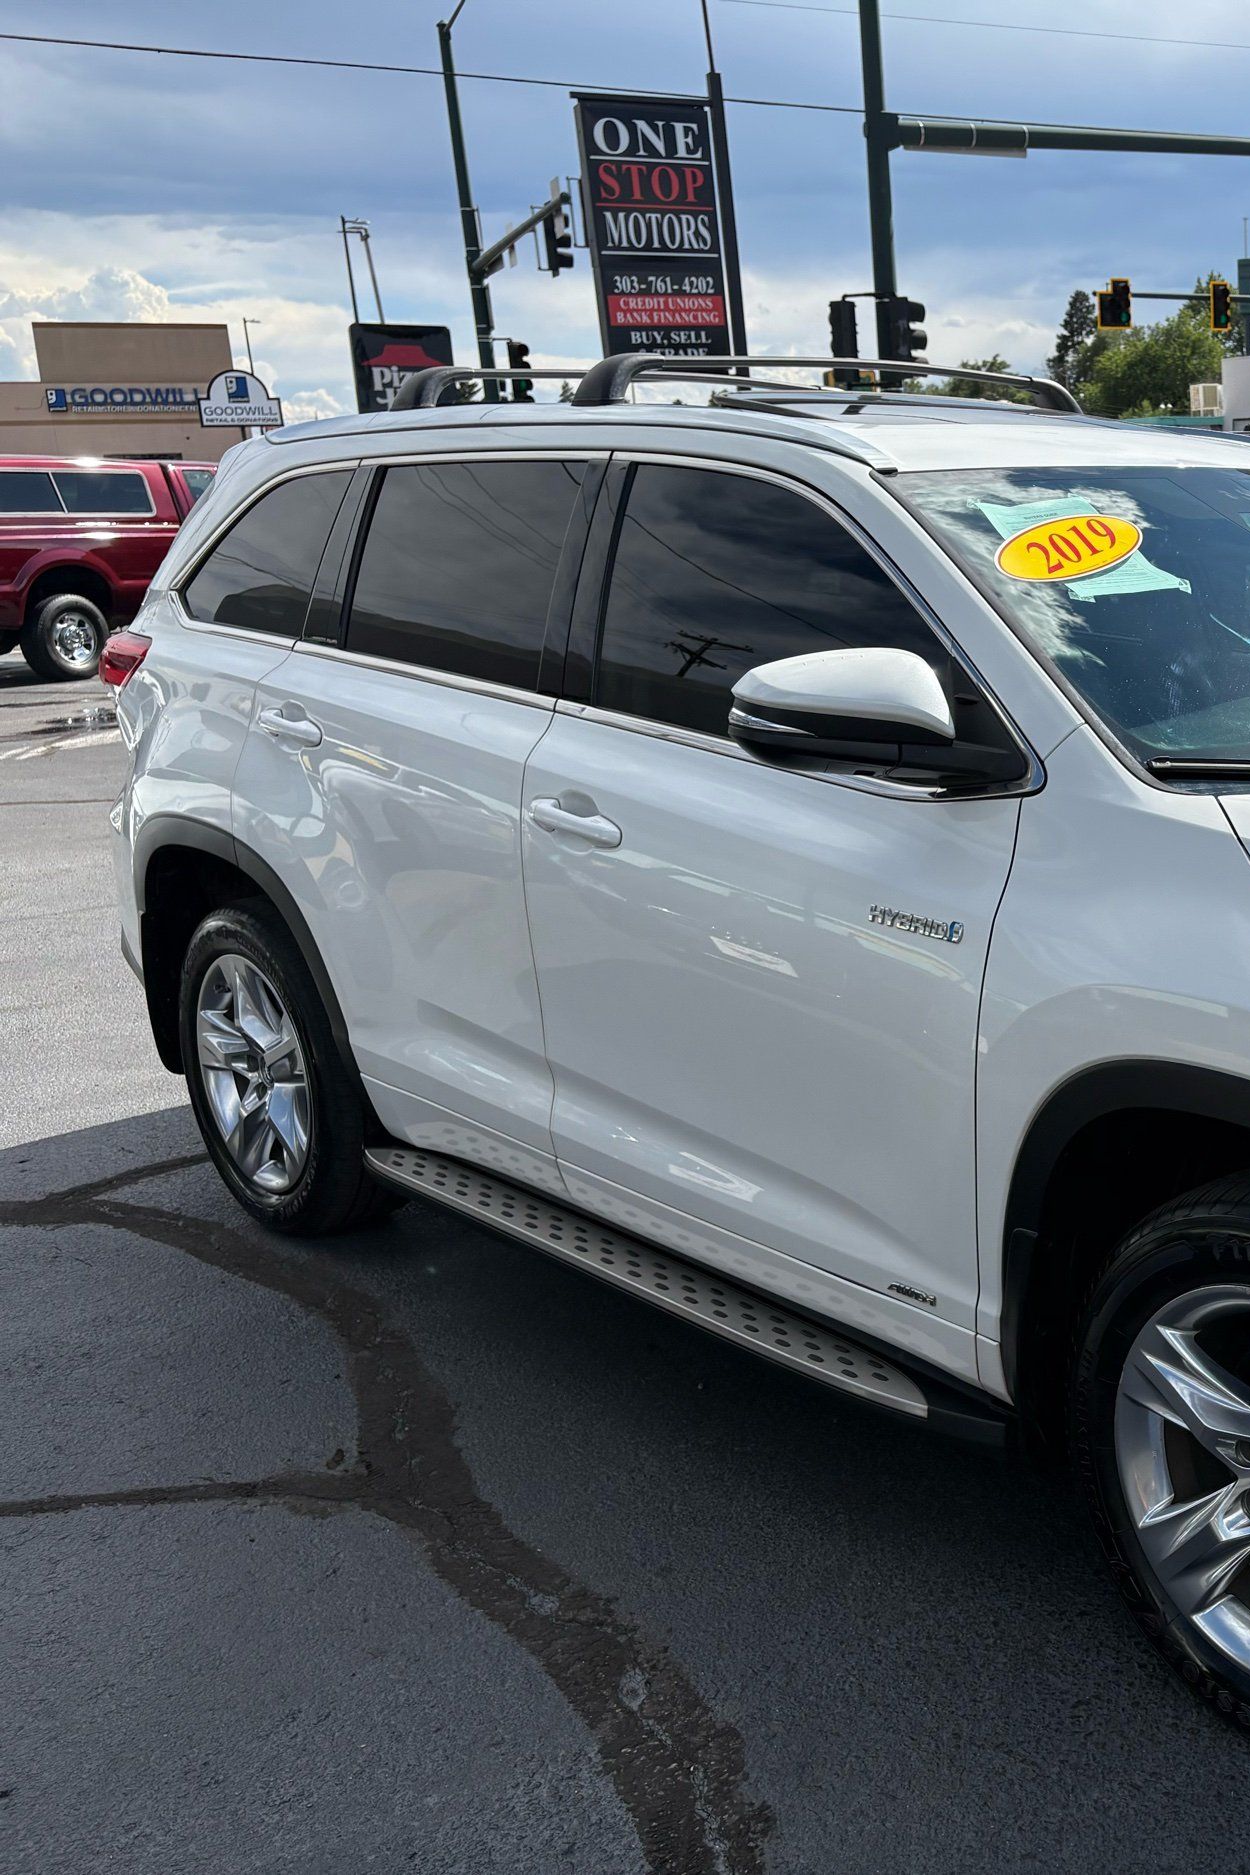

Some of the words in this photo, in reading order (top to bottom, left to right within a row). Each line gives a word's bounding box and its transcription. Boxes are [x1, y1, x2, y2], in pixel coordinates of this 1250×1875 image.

[593, 116, 702, 159] ONE
[598, 162, 705, 202] STOP
[603, 210, 712, 251] MOTORS
[616, 311, 651, 324] BANK
[653, 311, 719, 324] FINANCING
[620, 297, 665, 310] CREDIT
[668, 298, 713, 310] UNIONS
[630, 330, 668, 346] BUY,
[670, 330, 712, 344] SELL
[203, 406, 278, 416] GOODWILL
[1026, 518, 1117, 575] 2019
[868, 903, 948, 940] HYBRID
